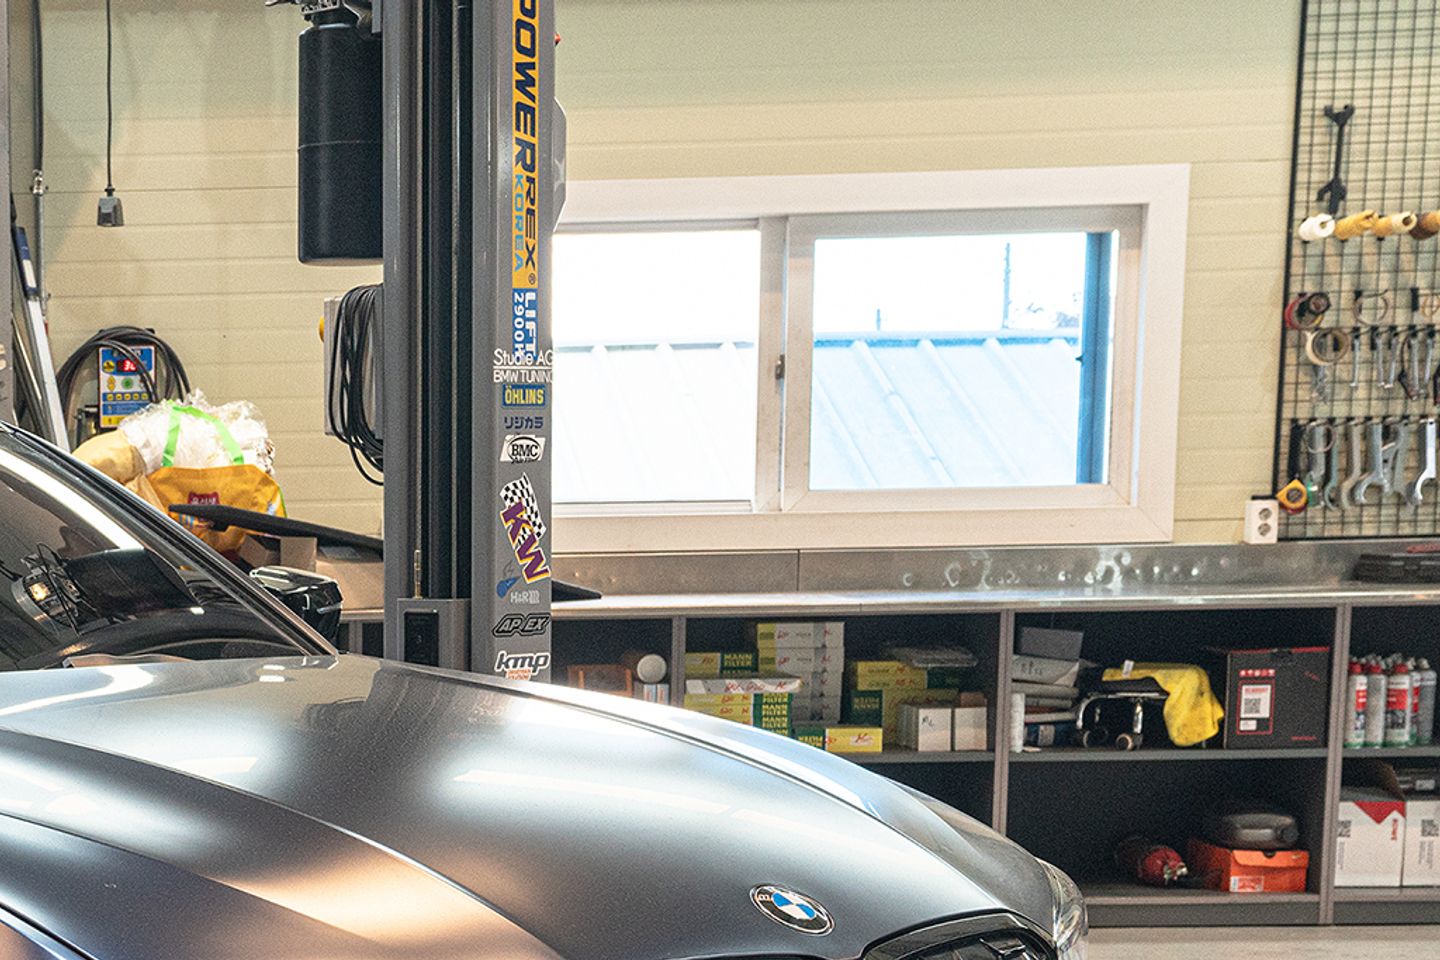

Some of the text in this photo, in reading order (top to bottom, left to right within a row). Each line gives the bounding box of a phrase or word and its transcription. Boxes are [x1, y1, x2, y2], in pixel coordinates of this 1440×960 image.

[514, 174, 525, 271] KOREA
[525, 291, 536, 357] LIFT
[493, 370, 518, 382] BMW
[505, 385, 544, 404] ÖHLINS
[511, 444, 539, 457] BMC
[500, 500, 551, 583] KW
[494, 615, 550, 635] APEX
